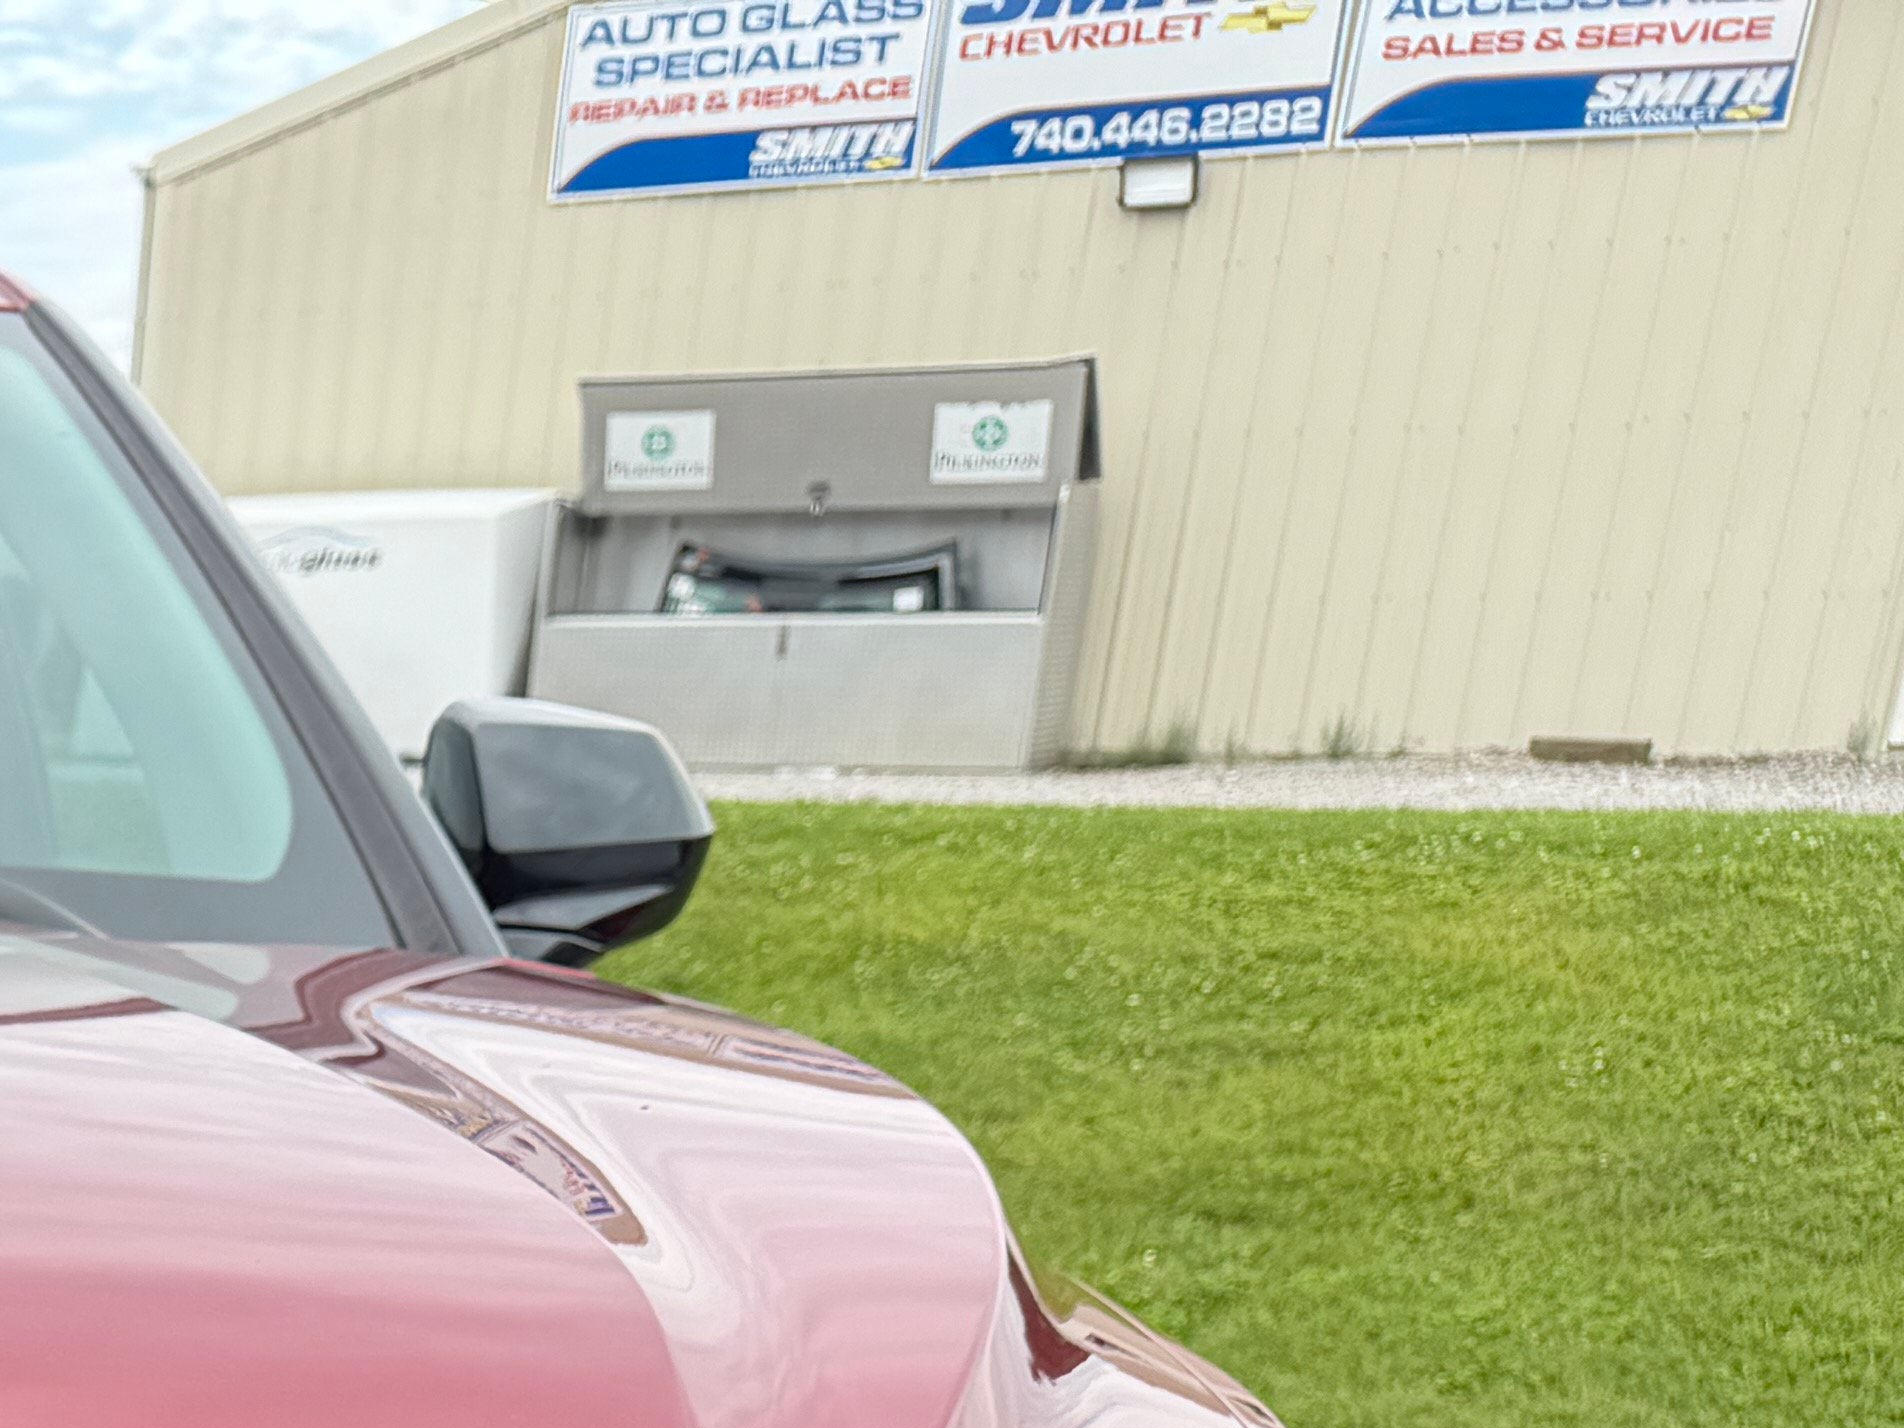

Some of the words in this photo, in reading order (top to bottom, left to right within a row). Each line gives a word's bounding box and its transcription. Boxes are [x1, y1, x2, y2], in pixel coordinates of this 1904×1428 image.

[579, 8, 727, 48] AUTO
[741, 0, 925, 33] GLASS
[960, 12, 1212, 60] CHEVROLET
[1381, 28, 1525, 60] SALES
[1534, 27, 1566, 52] &
[1575, 15, 1776, 50] SERVICE
[593, 33, 901, 87] SPECIALIST
[568, 91, 698, 125] REPAIR
[703, 88, 730, 113] &
[737, 75, 912, 111] REPLACE
[1585, 65, 1790, 108] SMITH
[749, 119, 915, 162] SMITH
[1011, 97, 1322, 158] 740.446.2282
